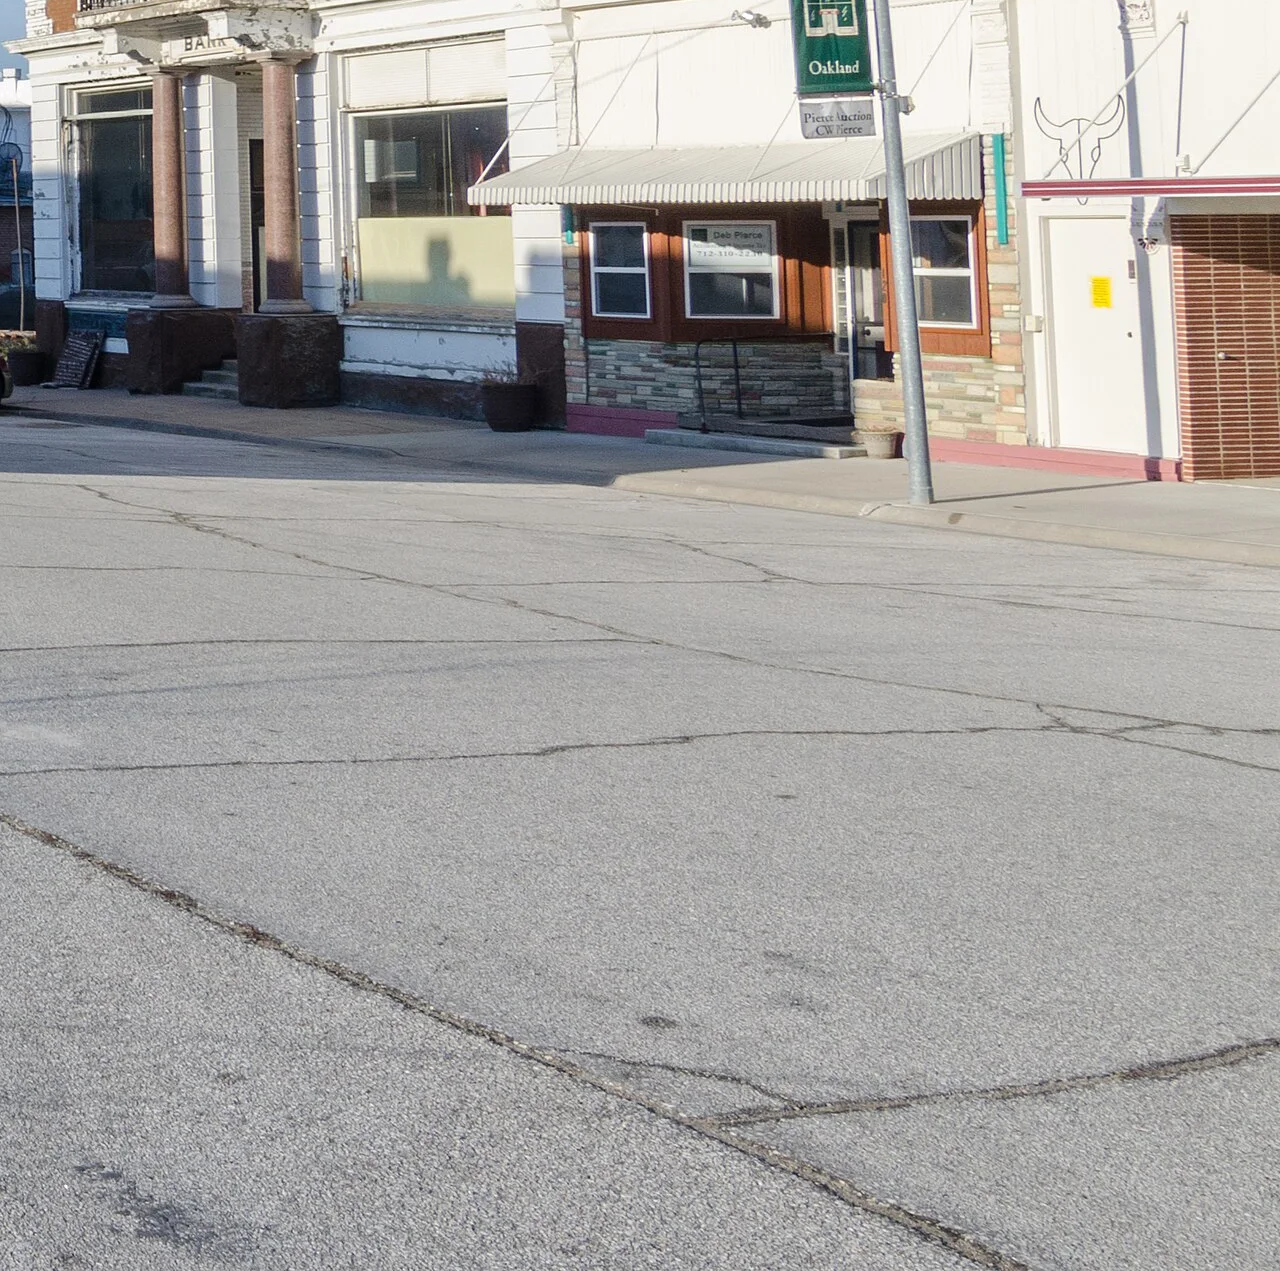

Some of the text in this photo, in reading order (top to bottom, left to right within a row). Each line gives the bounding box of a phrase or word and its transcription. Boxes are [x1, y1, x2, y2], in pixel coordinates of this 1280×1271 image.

[809, 60, 859, 75] Oakland
[804, 112, 834, 124] Pierce
[815, 124, 834, 136] CW
[713, 231, 763, 239] Deb Pierce
